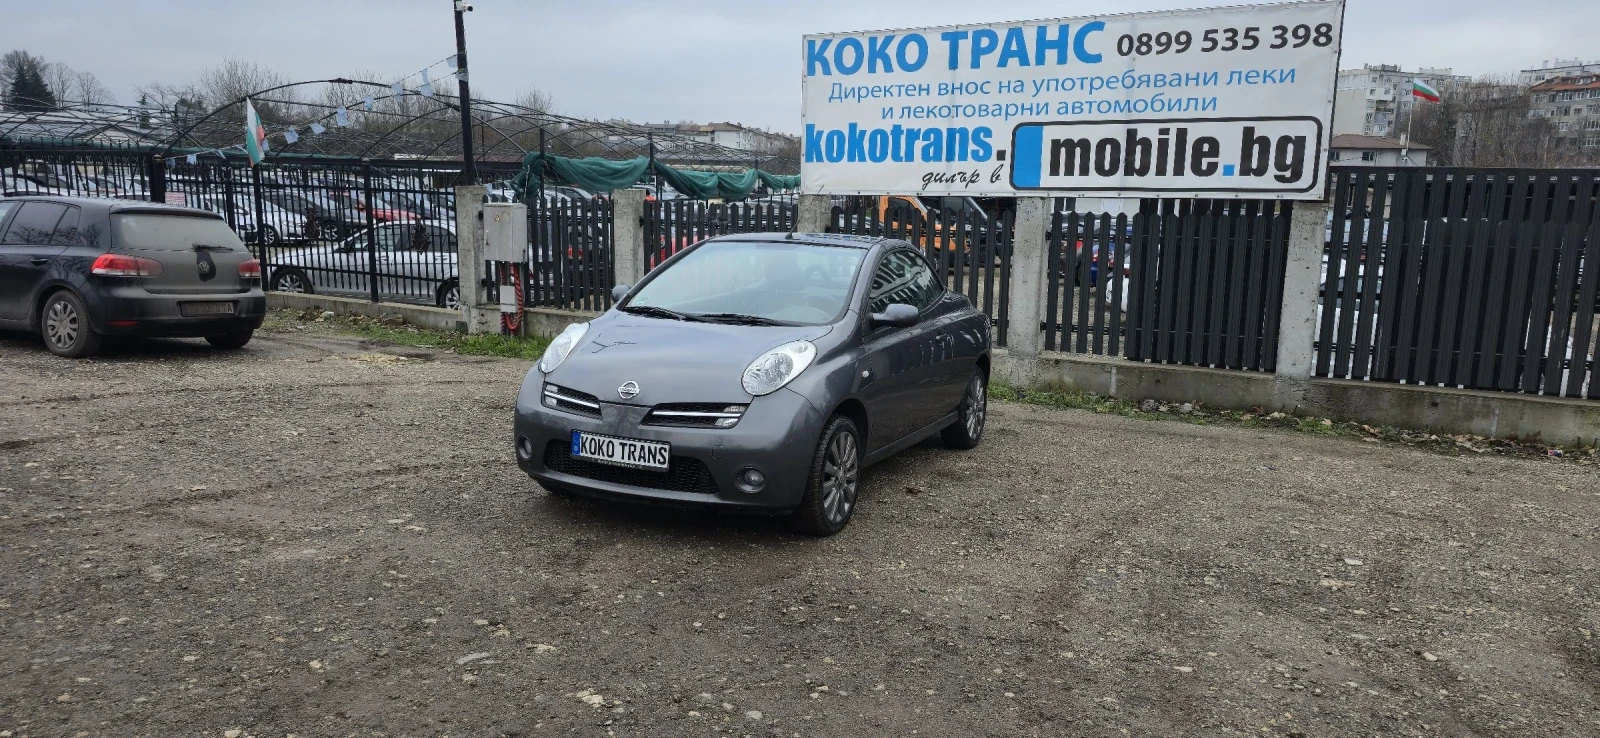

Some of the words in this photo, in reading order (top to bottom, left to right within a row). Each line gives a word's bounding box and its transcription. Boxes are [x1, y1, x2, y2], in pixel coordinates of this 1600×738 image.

[806, 33, 928, 76] КОКО
[941, 22, 1105, 70] ТРАНС
[1116, 30, 1193, 57] 0899
[1201, 27, 1260, 52] 535
[1270, 22, 1333, 49] 398
[828, 82, 931, 103] Директен
[937, 80, 992, 96] внос
[998, 79, 1024, 93] на
[1032, 69, 1218, 95] употребявани
[1226, 68, 1296, 86] леки
[881, 106, 894, 119] и
[898, 102, 1050, 121] лекотоварни
[1056, 92, 1218, 116] автомобили
[1049, 126, 1307, 184] mobile.bg
[922, 168, 981, 190] дилър
[581, 436, 614, 458] KOKO
[619, 442, 667, 465] TRANS
